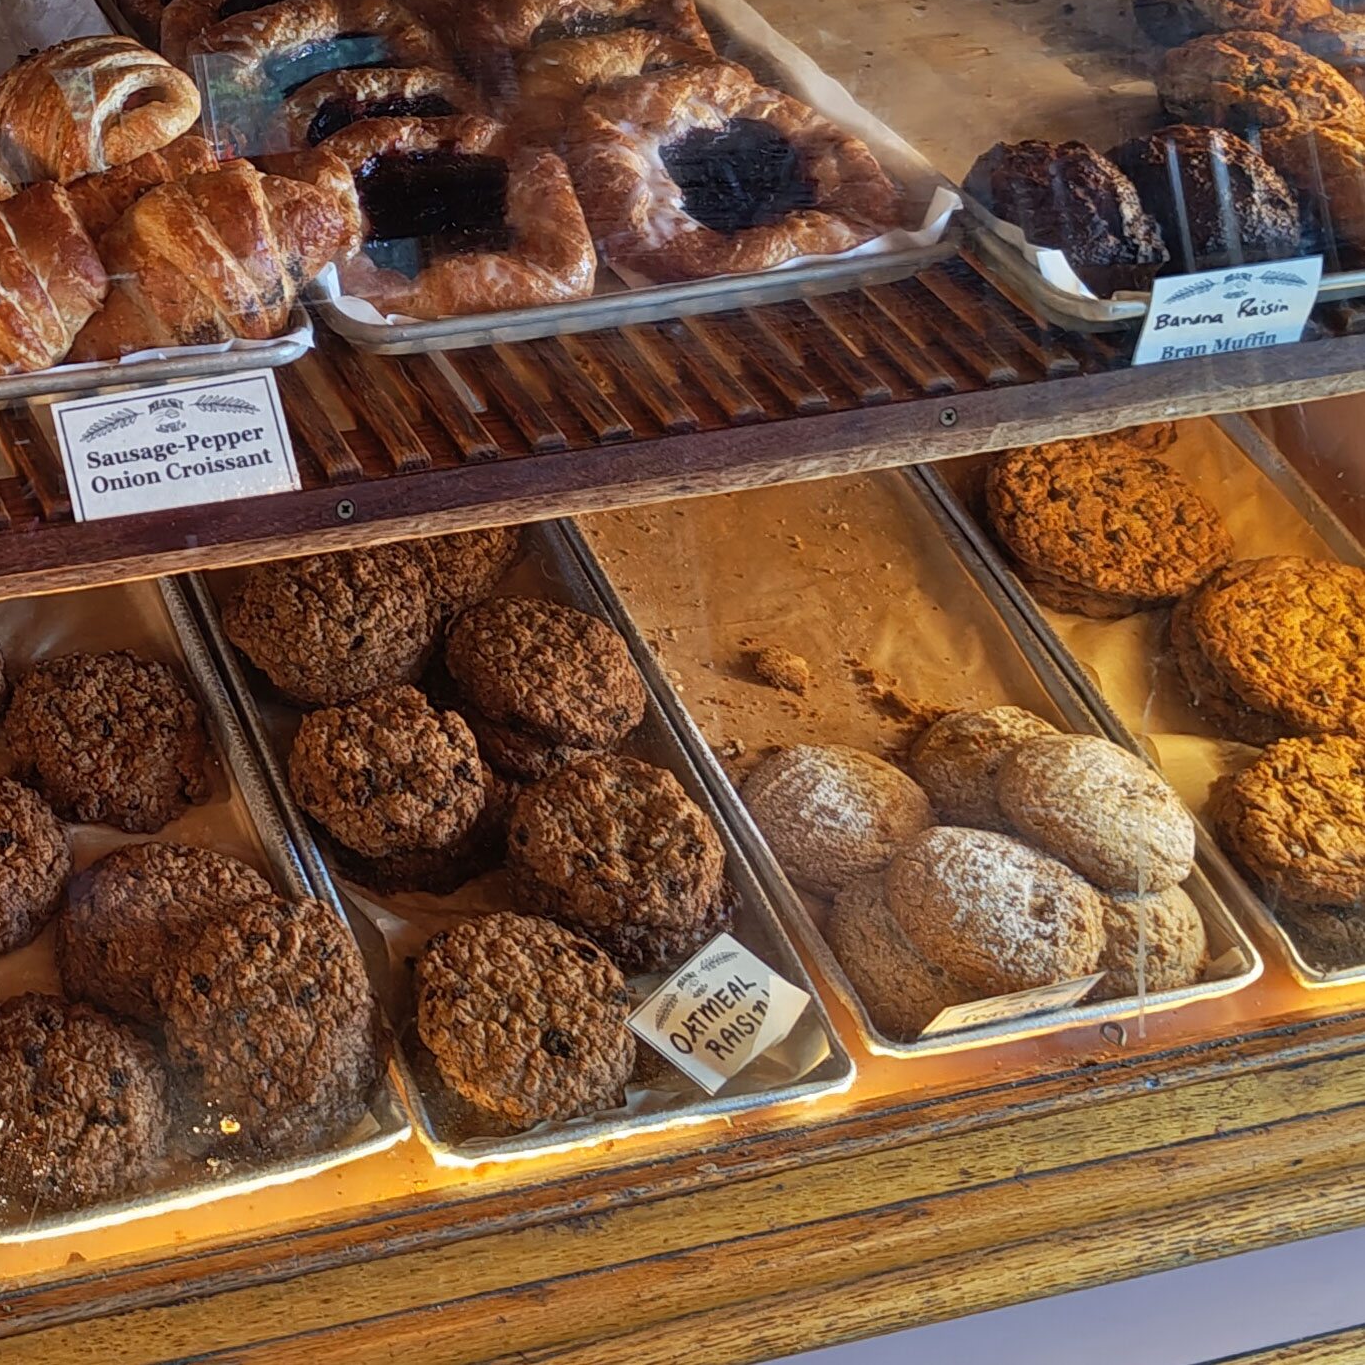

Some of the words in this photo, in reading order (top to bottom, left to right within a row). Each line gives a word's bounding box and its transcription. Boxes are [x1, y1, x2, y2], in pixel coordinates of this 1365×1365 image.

[1153, 313, 1223, 331] Banana
[1237, 298, 1289, 318] Raisin
[1160, 344, 1207, 361] Bran
[1212, 331, 1276, 353] Muffin
[86, 426, 264, 470] Sausage-Pepper
[91, 469, 161, 494] Onion
[165, 448, 273, 480] Croissant
[669, 974, 757, 1055] OATMEAL
